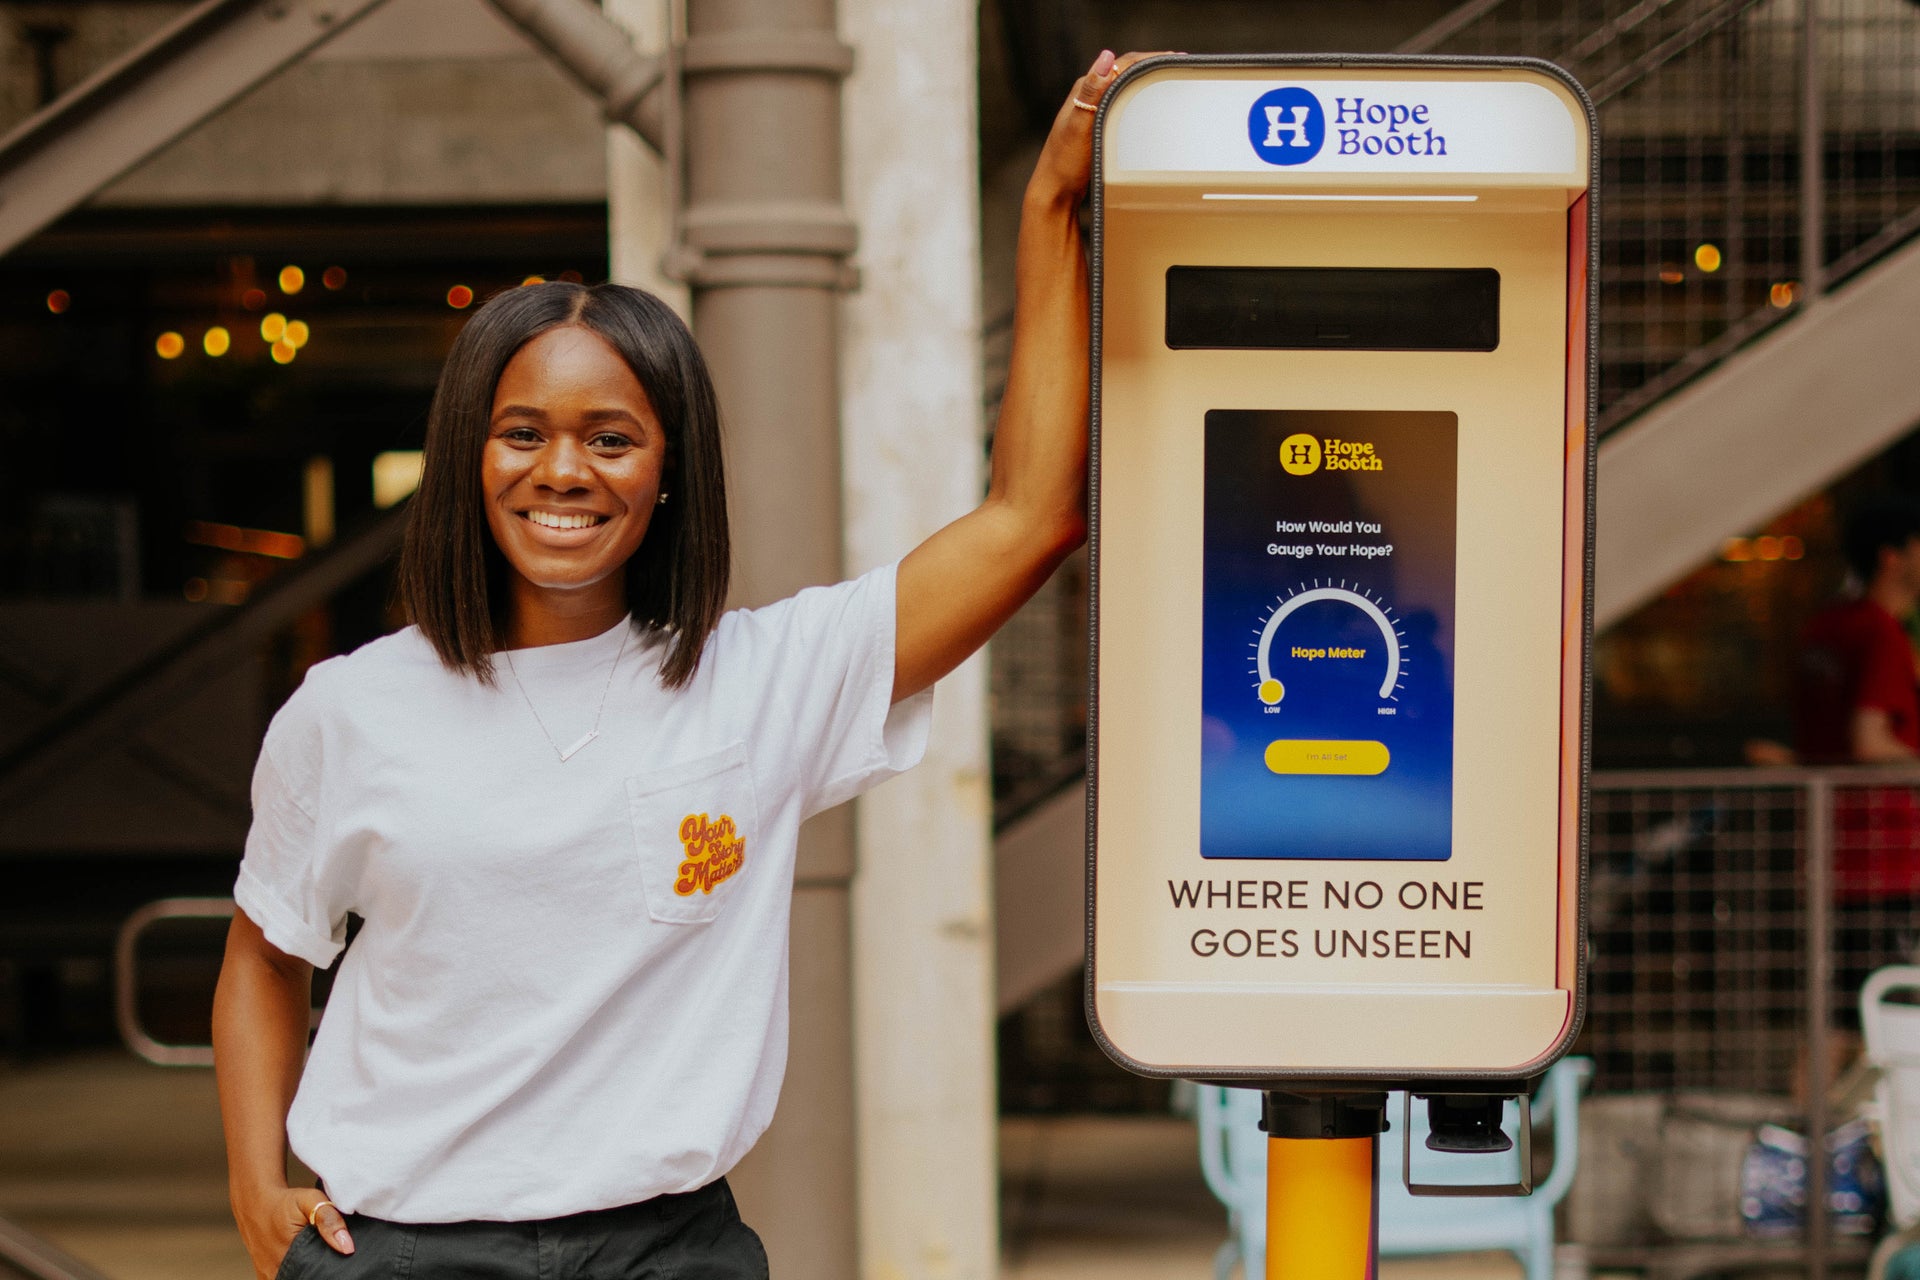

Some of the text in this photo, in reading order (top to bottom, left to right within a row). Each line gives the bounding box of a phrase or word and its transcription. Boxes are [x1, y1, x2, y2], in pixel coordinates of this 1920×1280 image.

[1334, 98, 1430, 132] Hope
[1337, 128, 1447, 156] Booth
[1324, 439, 1374, 460] Hope
[1325, 455, 1383, 471] Booth
[1276, 521, 1381, 534] How Would You
[1267, 543, 1393, 559] Gauge Your Hope?
[1291, 647, 1366, 661] Hope Meter
[1263, 706, 1281, 714] LOW
[1377, 707, 1396, 716] HIGH
[1321, 753, 1332, 761] All
[1334, 753, 1348, 761] Set
[681, 816, 735, 857] Your
[708, 840, 744, 866] Story
[1168, 880, 1484, 910] WHERE NO ONE
[1190, 929, 1472, 959] GOES UNSEEN
